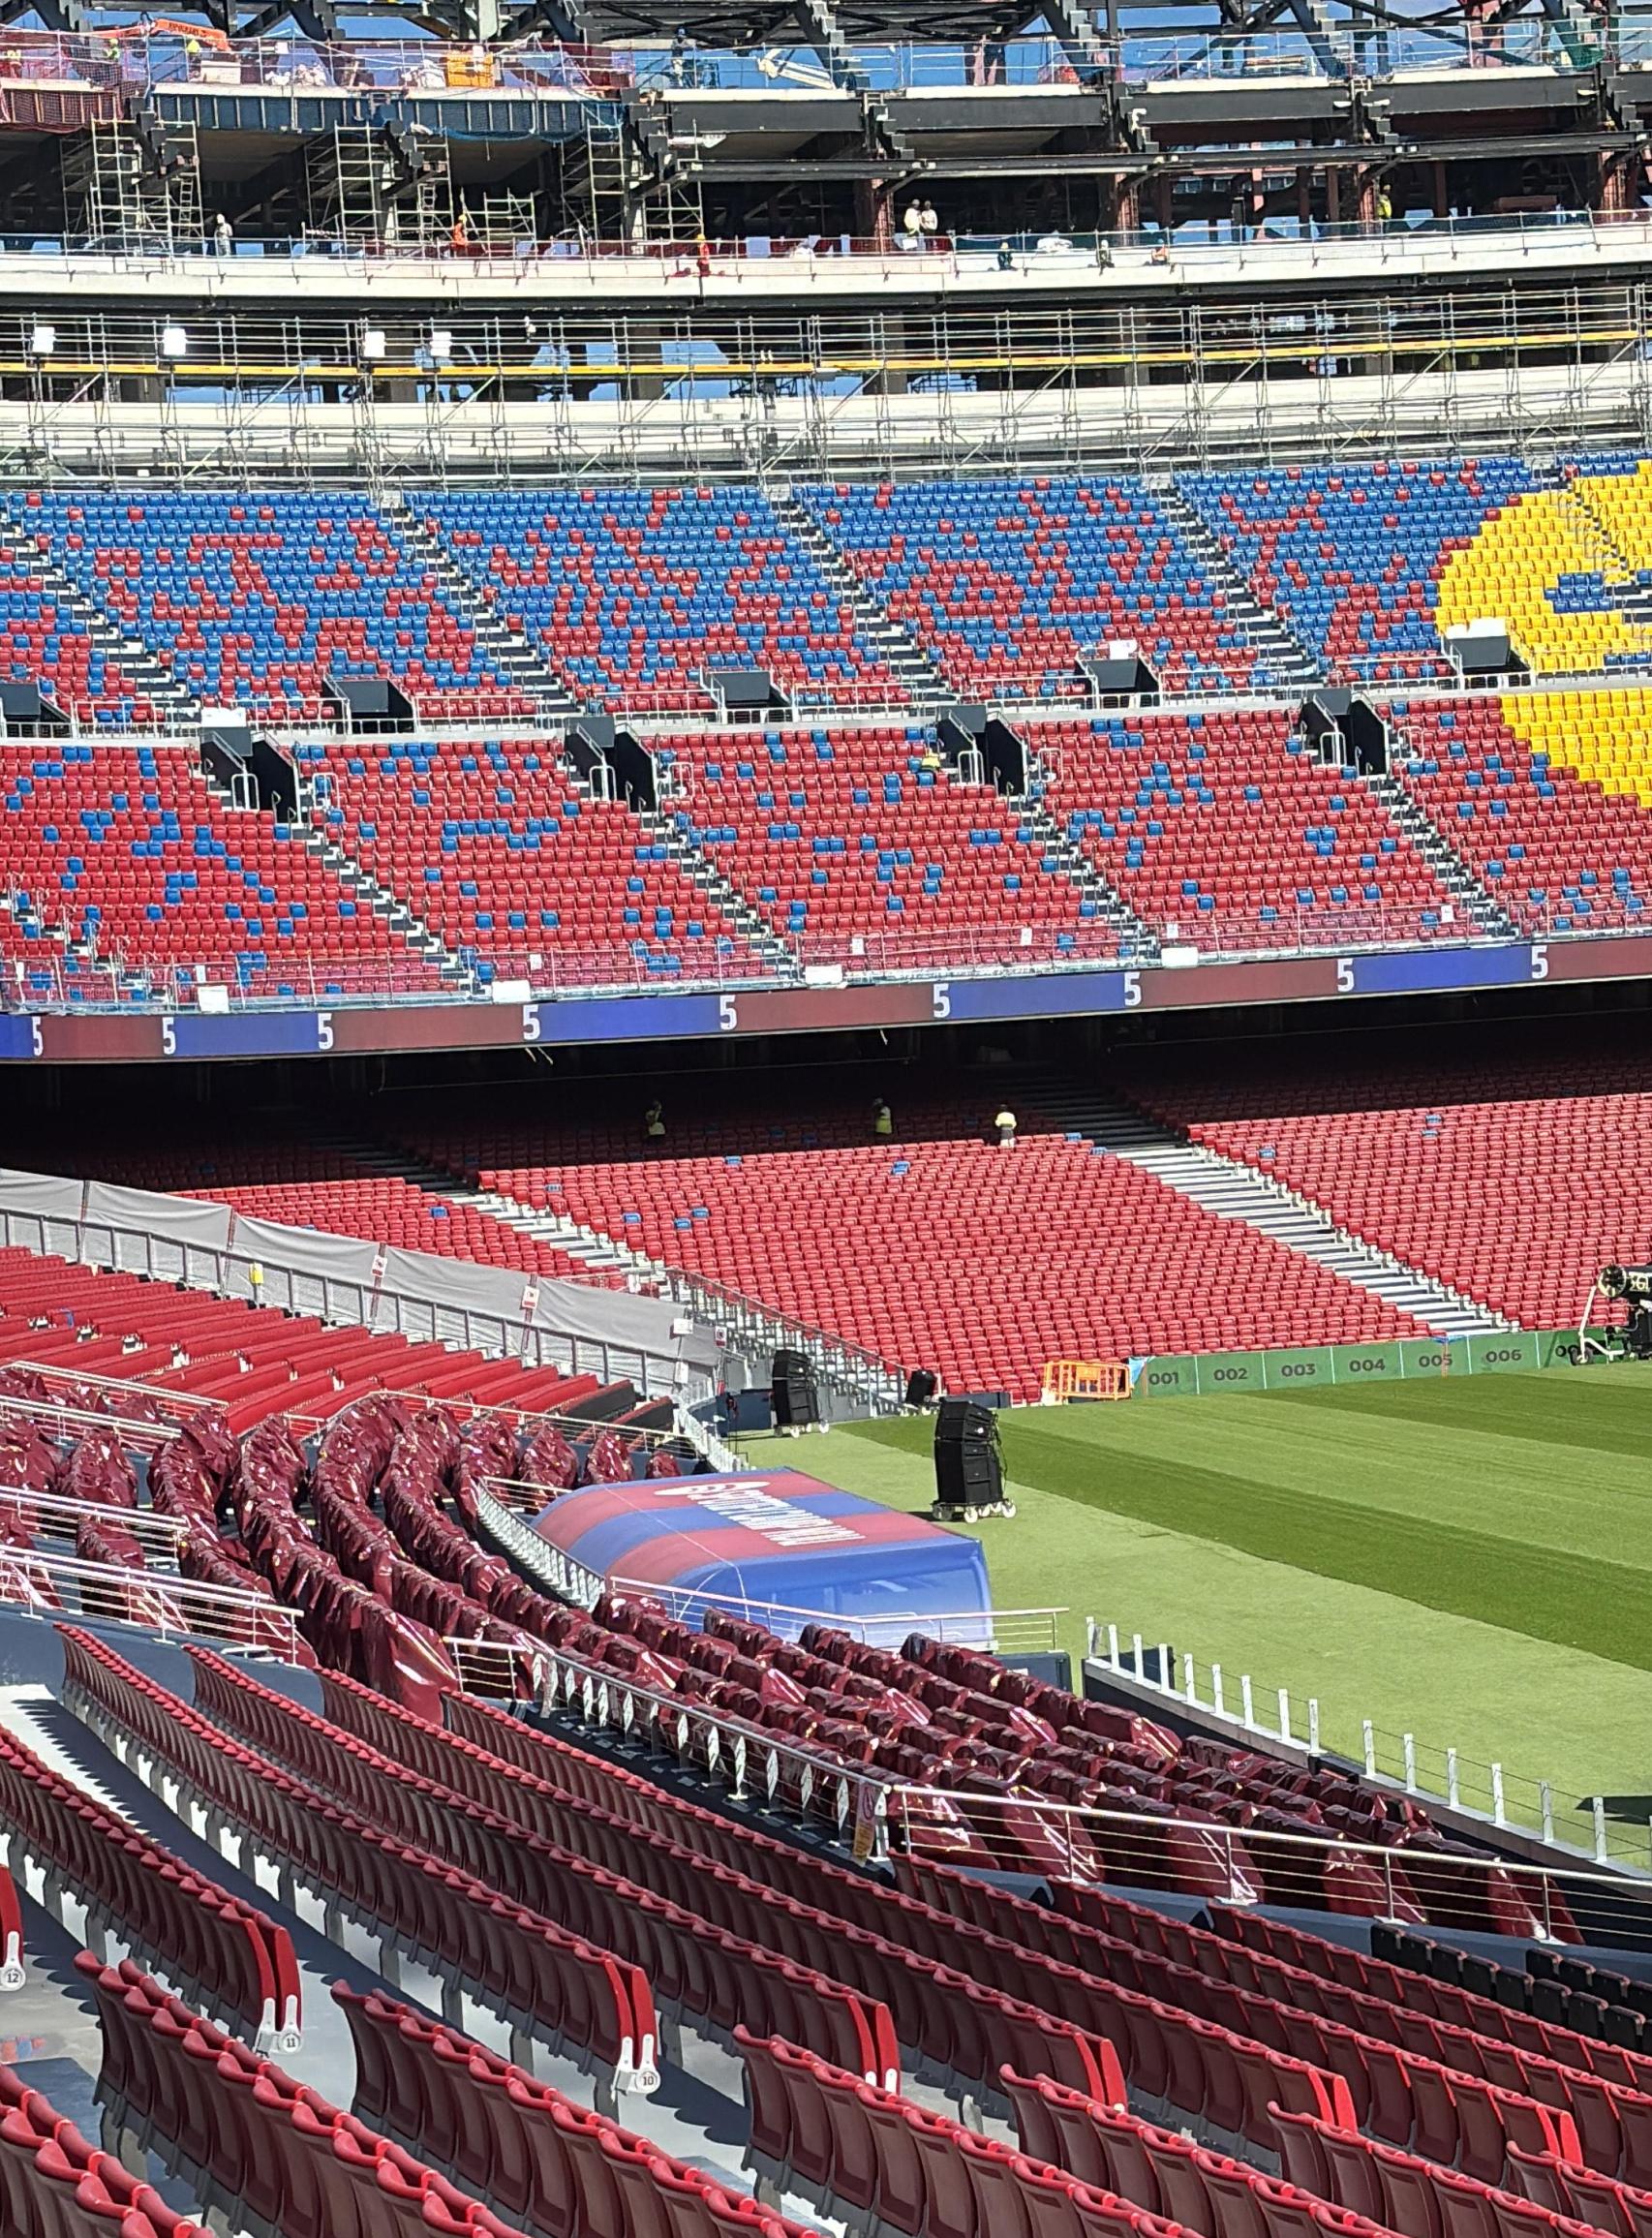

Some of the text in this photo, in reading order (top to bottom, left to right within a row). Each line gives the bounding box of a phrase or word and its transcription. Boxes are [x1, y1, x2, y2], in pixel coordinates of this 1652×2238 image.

[1531, 945, 1548, 979] 5
[1337, 959, 1355, 993] 5
[933, 983, 951, 1018] 5
[1123, 972, 1142, 1006] 5
[522, 1004, 540, 1041] 5
[719, 995, 738, 1030] 5
[31, 1017, 44, 1057] 5
[162, 1017, 176, 1055] 5
[318, 1013, 334, 1050] 5
[1349, 1358, 1387, 1372] 004
[1419, 1353, 1453, 1368] 005
[1485, 1349, 1523, 1364] 006
[1148, 1371, 1179, 1386] 001
[1213, 1367, 1249, 1382] 002
[1281, 1363, 1316, 1377] 003
[7, 1973, 19, 1983] 12
[286, 2038, 296, 2048] 11
[642, 2075, 655, 2086] 10
